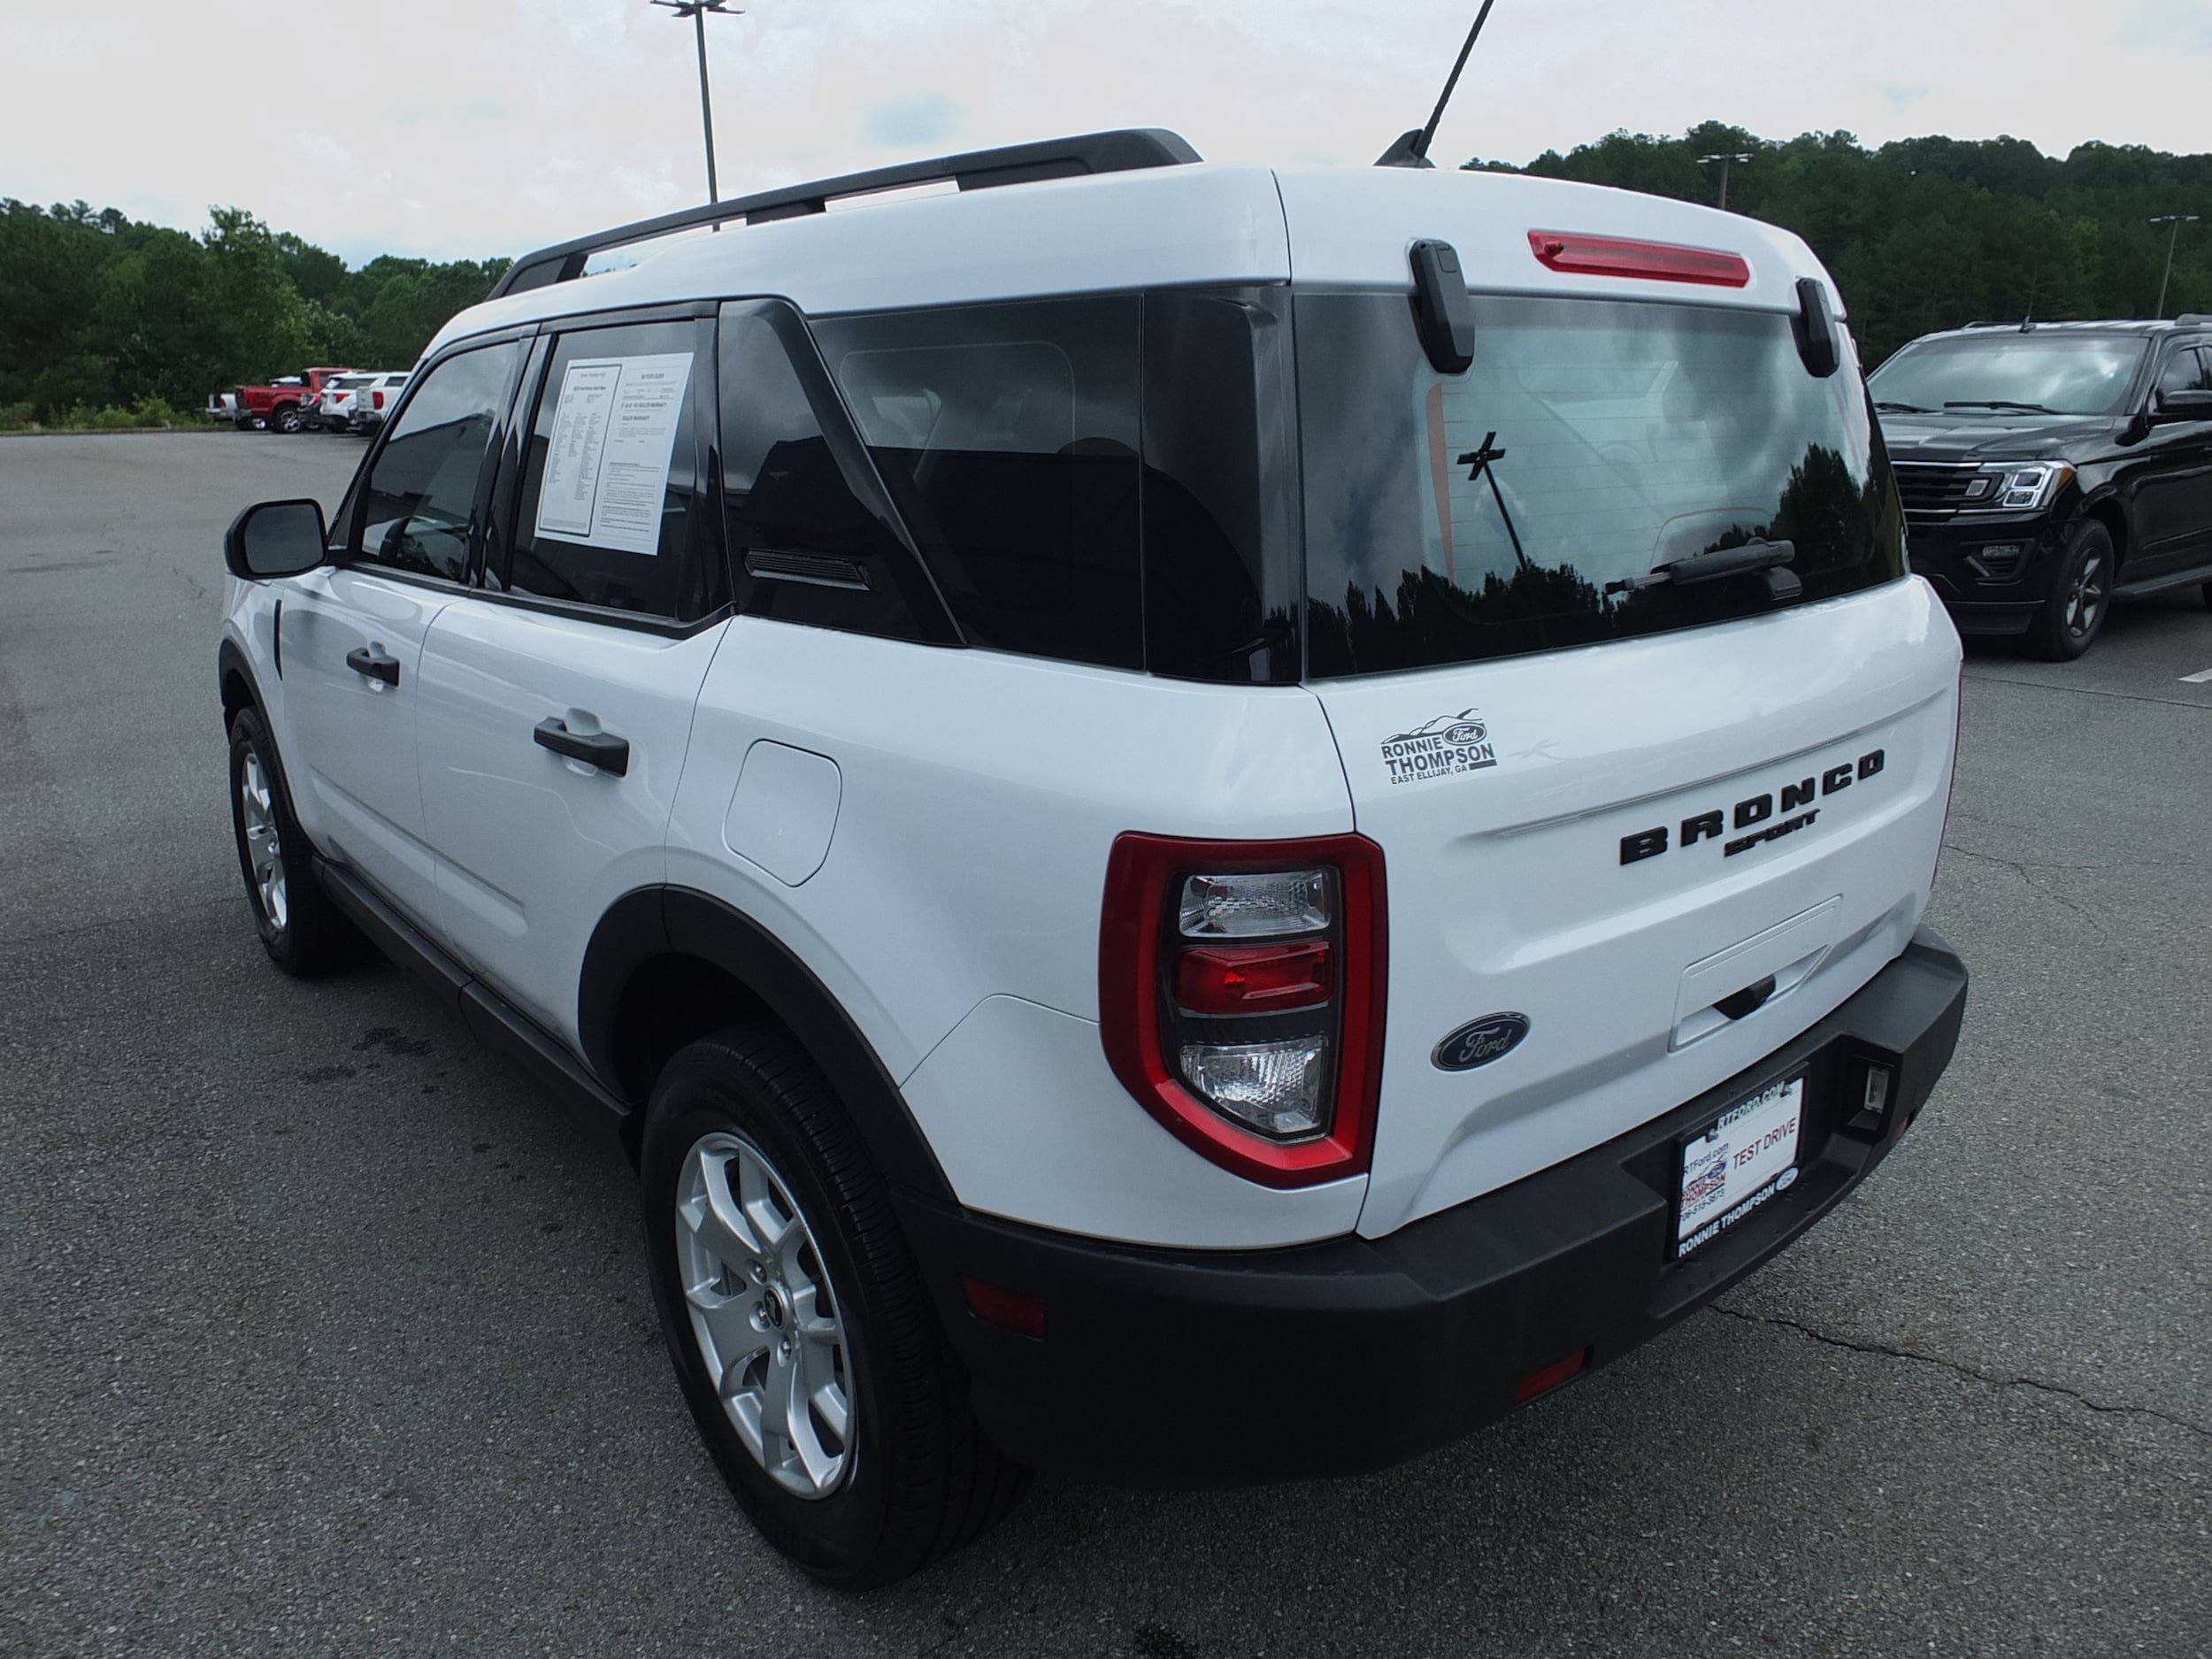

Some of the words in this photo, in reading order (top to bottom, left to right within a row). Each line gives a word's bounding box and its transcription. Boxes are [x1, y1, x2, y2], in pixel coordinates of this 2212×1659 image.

[1381, 736, 1444, 759] RONNIE
[1452, 727, 1479, 742] Ford
[1385, 742, 1495, 776] THOMPSON
[1391, 773, 1415, 785] EAST
[1417, 768, 1454, 780] ELLIJAY,
[1455, 764, 1468, 773] GA
[1619, 749, 1885, 865] BRONCO
[1724, 808, 1821, 857] SPORT
[1459, 1026, 1512, 1064] Ford
[1732, 1139, 1762, 1170] TEST
[1763, 1117, 1797, 1151] DRIVE
[1678, 1221, 1720, 1258] RONNIE
[1720, 1183, 1776, 1229] THOMPSON
